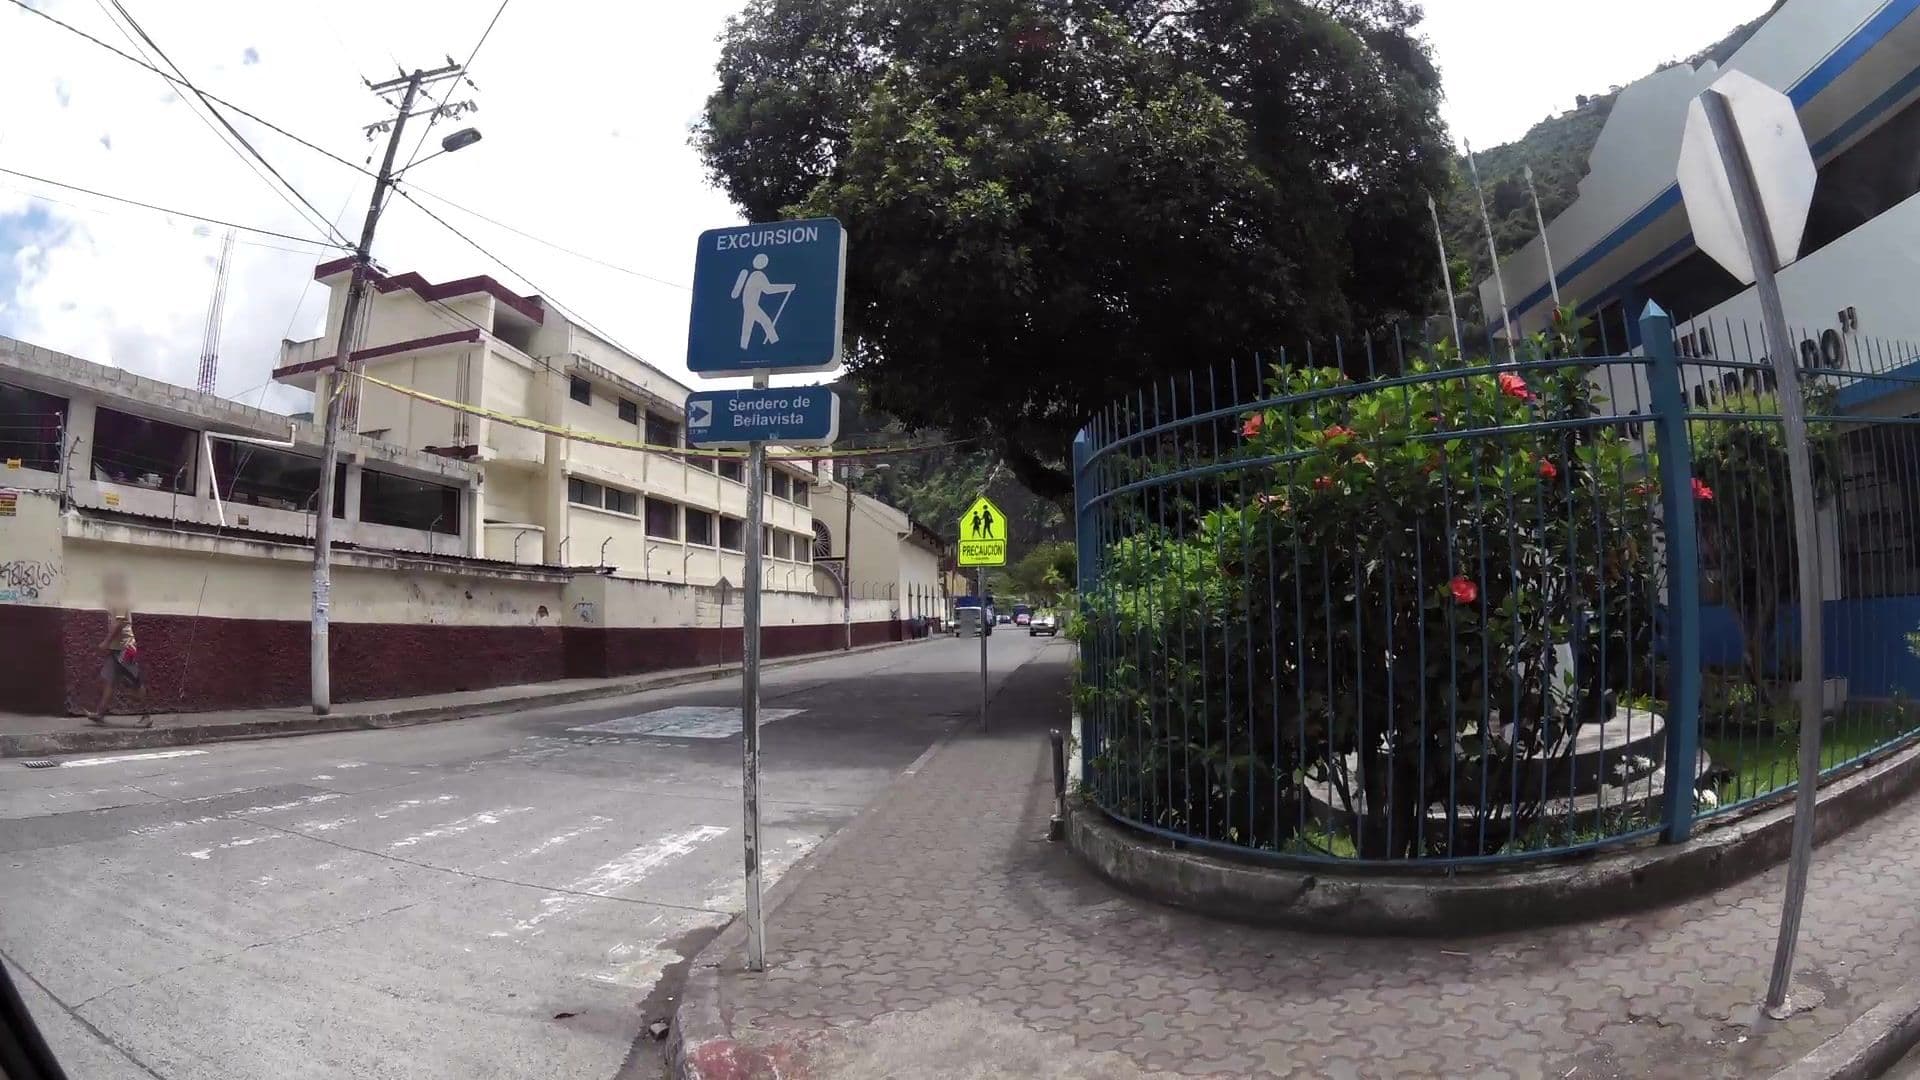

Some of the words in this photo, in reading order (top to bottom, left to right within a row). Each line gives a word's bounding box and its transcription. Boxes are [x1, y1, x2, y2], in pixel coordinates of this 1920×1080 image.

[716, 226, 819, 251] EXCURSION
[728, 396, 789, 412] Sendero
[792, 395, 811, 408] de
[733, 413, 804, 427] Bellavista
